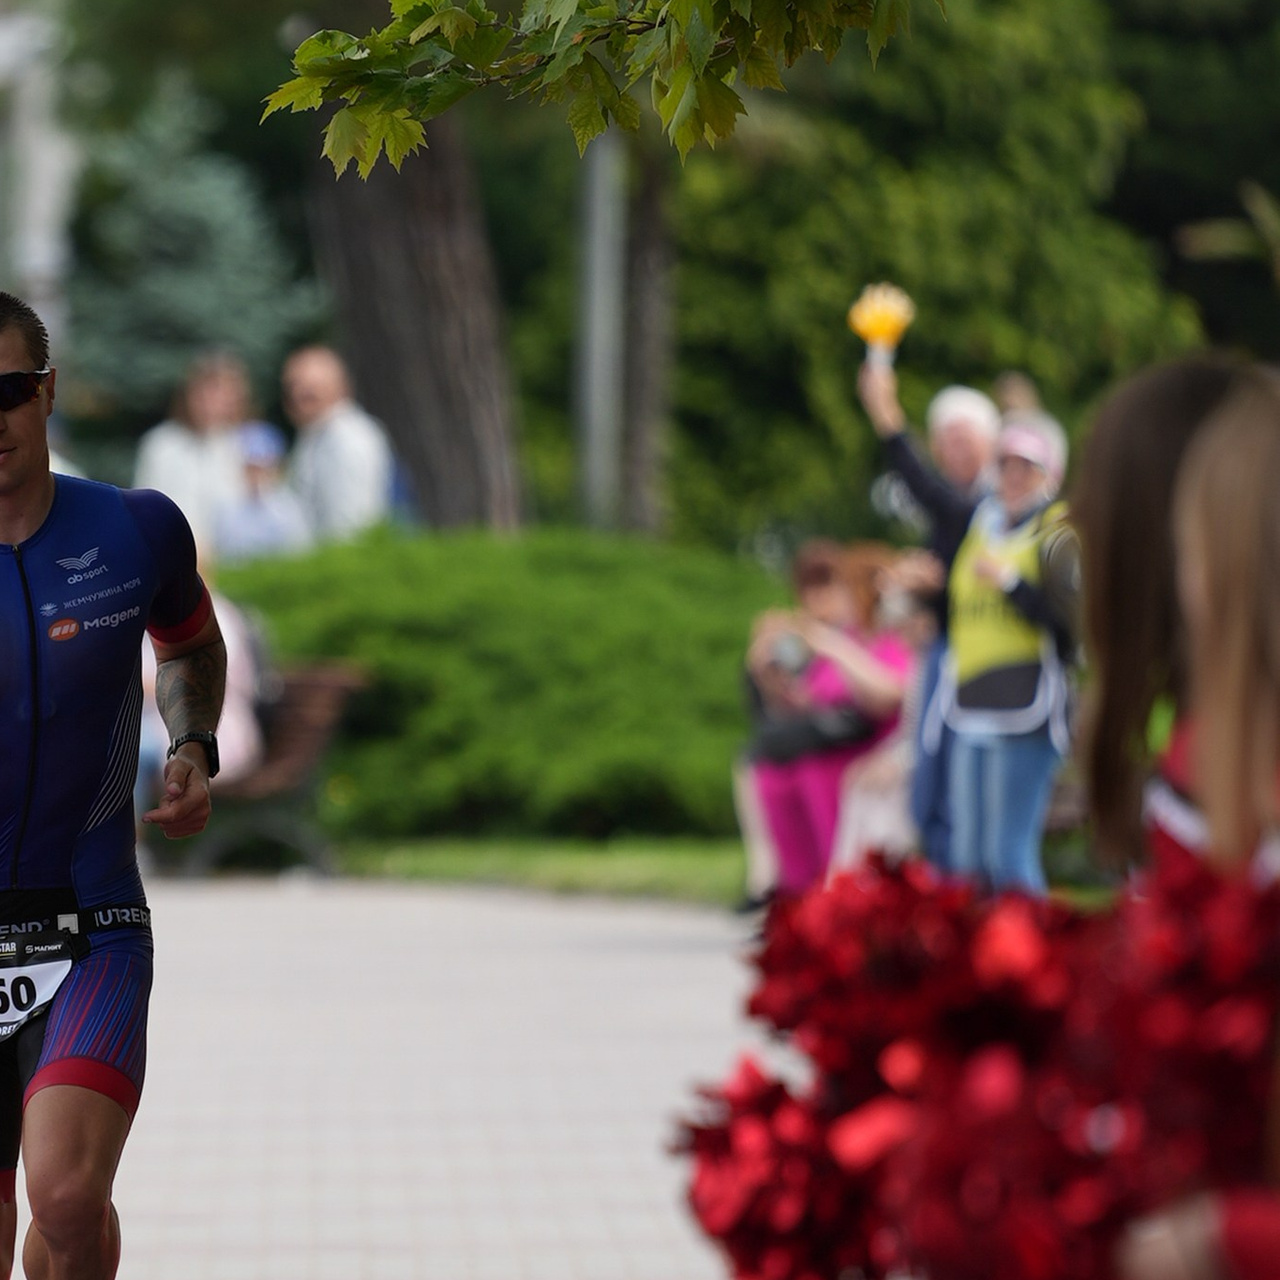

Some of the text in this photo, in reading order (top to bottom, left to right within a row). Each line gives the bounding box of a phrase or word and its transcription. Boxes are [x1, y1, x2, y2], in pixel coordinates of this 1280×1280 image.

[63, 577, 141, 609] ЖЕМЧУЖИНА МОРЯ
[83, 606, 140, 630] Magene
